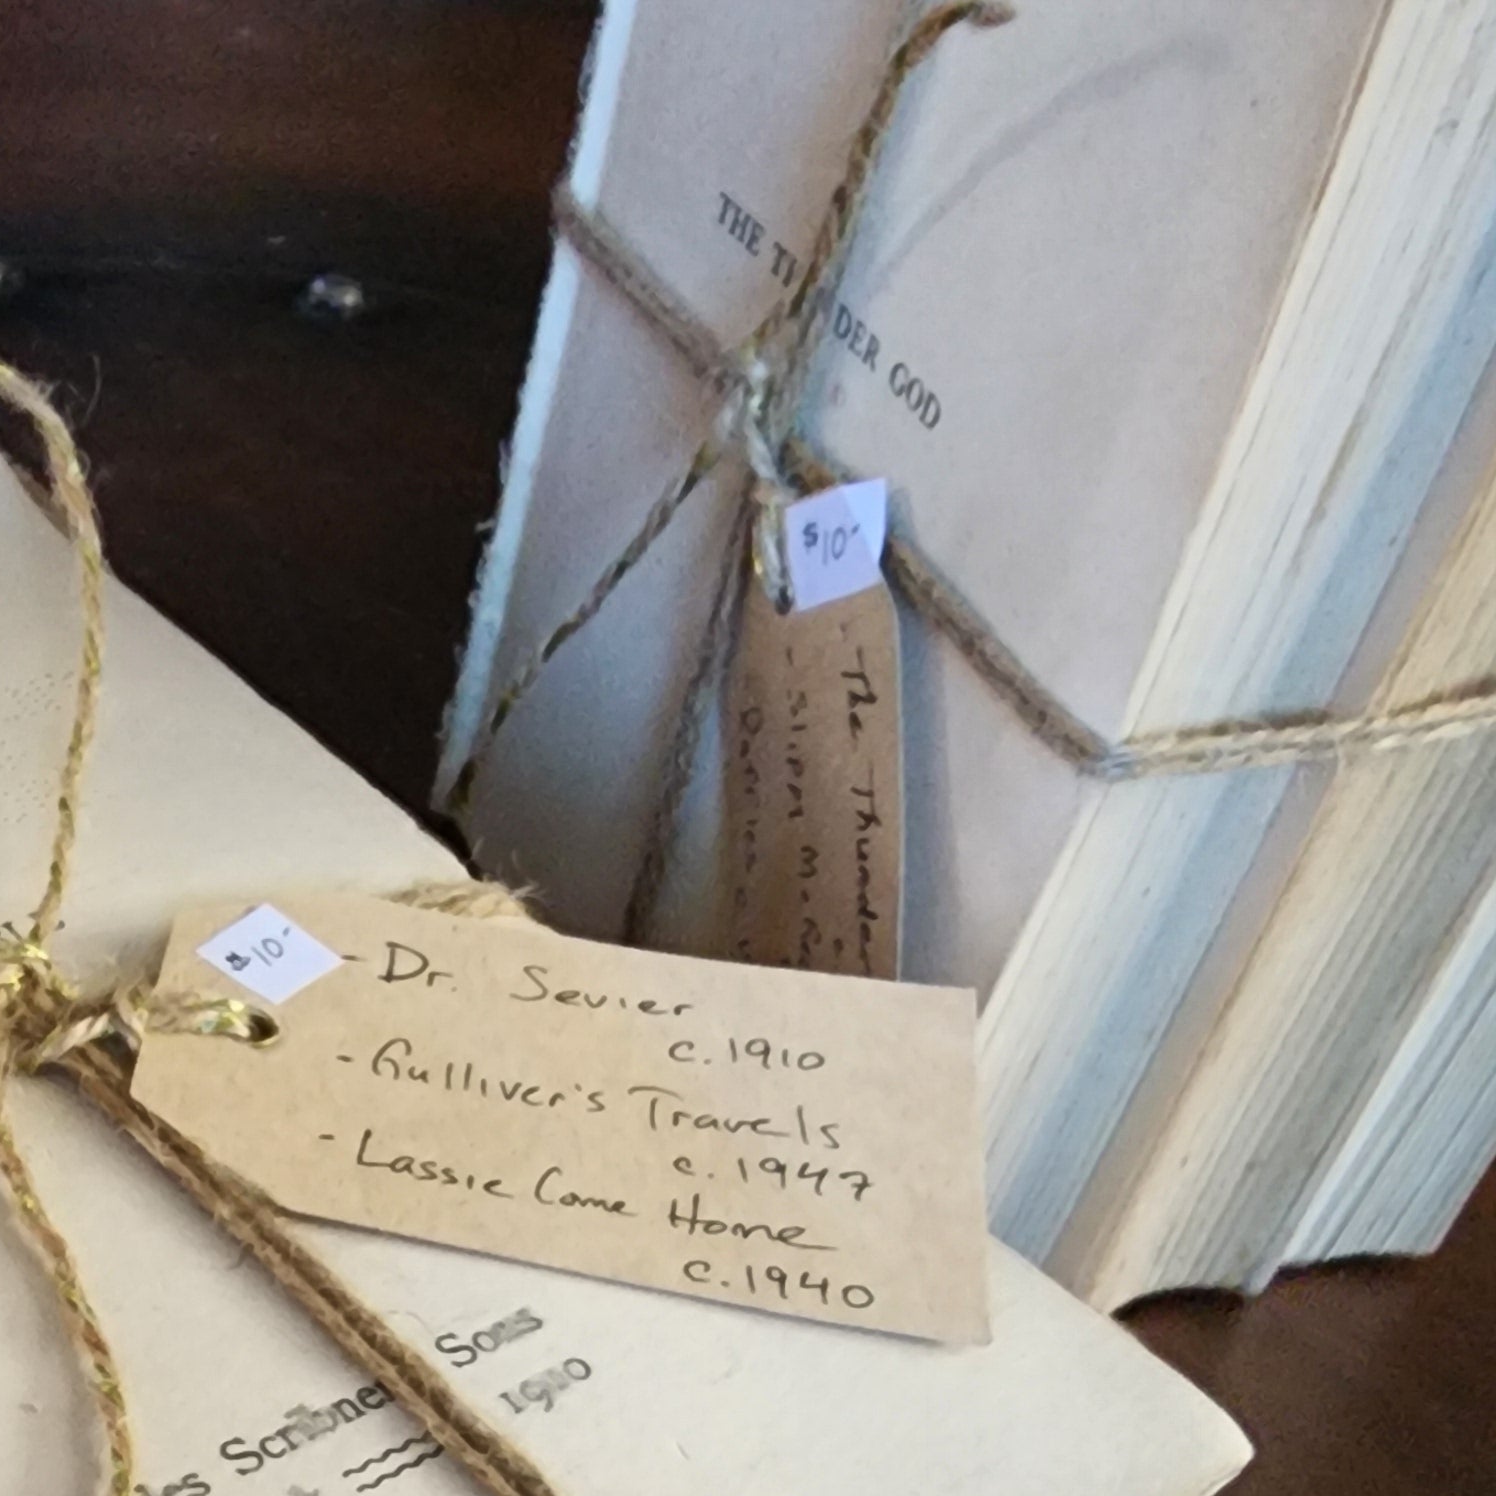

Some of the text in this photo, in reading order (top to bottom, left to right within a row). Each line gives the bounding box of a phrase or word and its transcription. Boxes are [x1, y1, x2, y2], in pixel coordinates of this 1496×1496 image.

[717, 191, 765, 258] THE
[888, 362, 943, 432] GOD
[378, 942, 460, 993] Dr.
[508, 963, 696, 1019] Sevier
[370, 1036, 607, 1113] Gulliver's
[628, 1084, 842, 1151] Travels
[356, 1127, 515, 1199] Lassie
[534, 1167, 639, 1218] Come
[667, 1193, 837, 1252] Home
